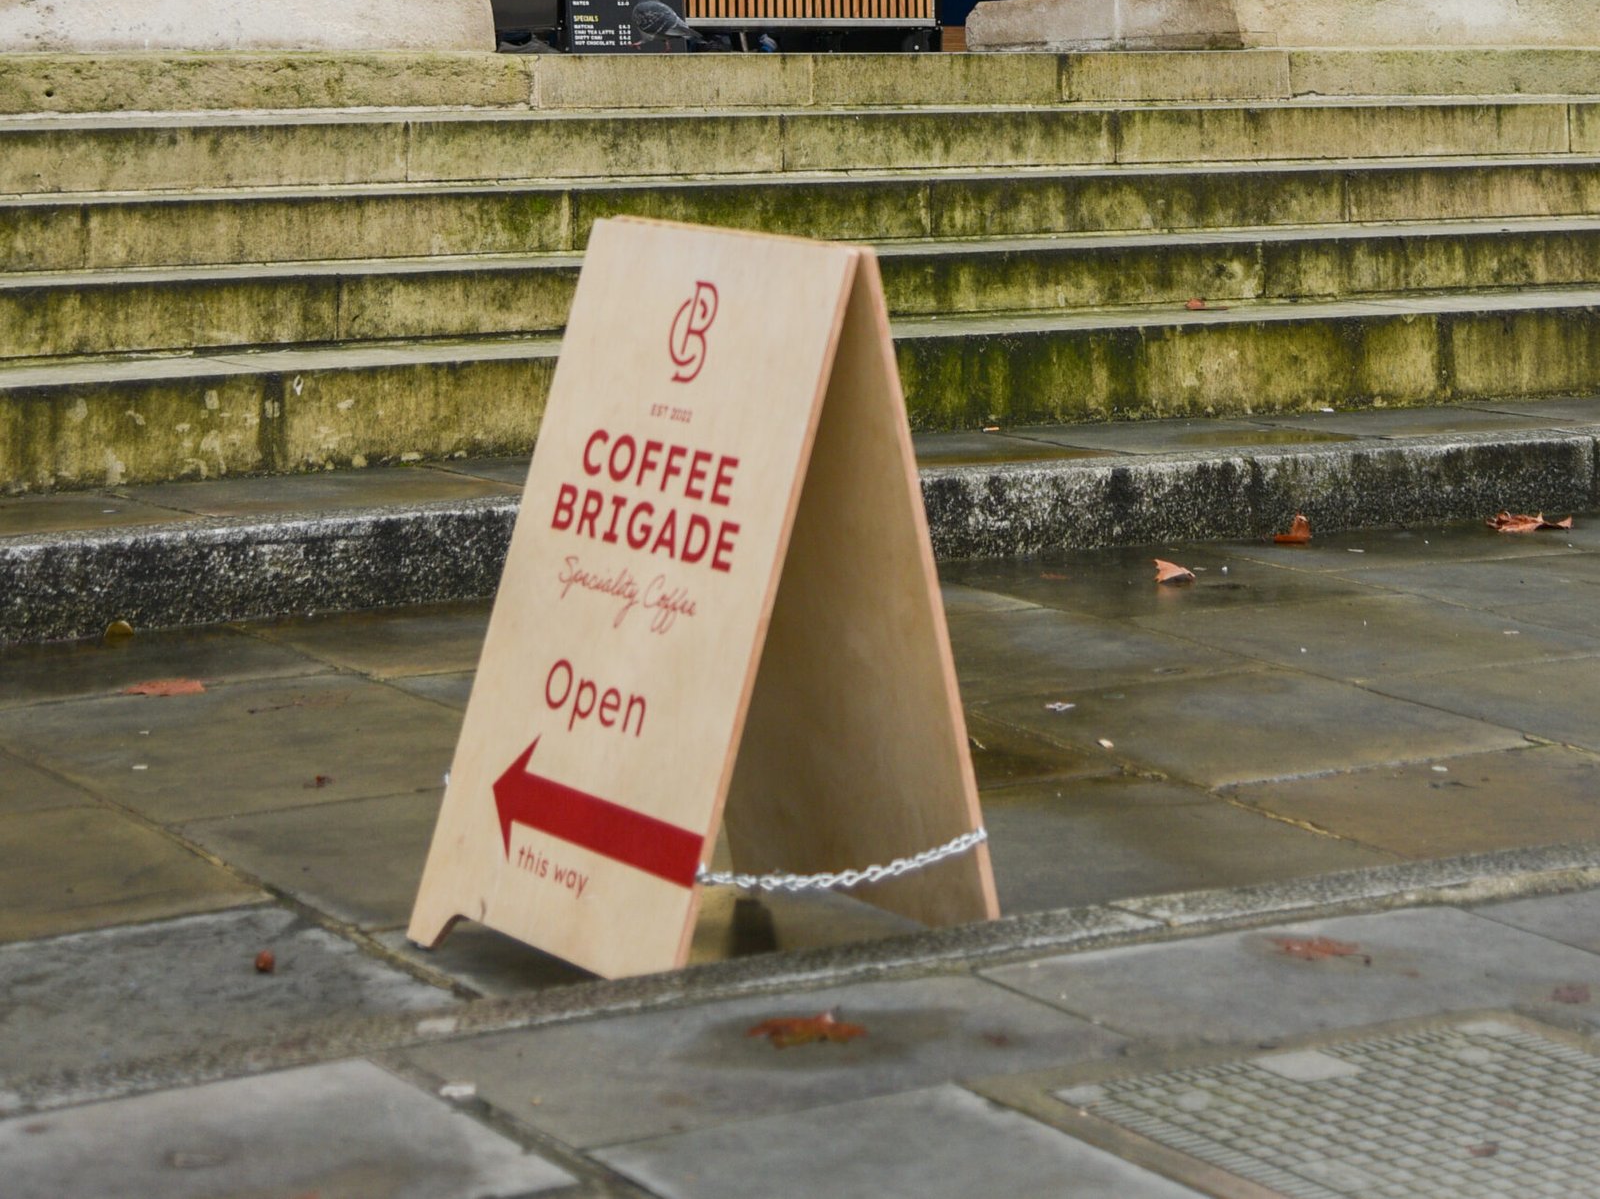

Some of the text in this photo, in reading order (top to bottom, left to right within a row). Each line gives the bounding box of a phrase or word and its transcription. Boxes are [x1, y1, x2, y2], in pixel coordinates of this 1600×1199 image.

[650, 403, 693, 424] EST 2022
[582, 429, 740, 507] COFFEE
[551, 482, 741, 574] BRIGADE
[642, 574, 698, 635] Coffee
[545, 658, 646, 738] Open
[517, 846, 589, 900] this way
